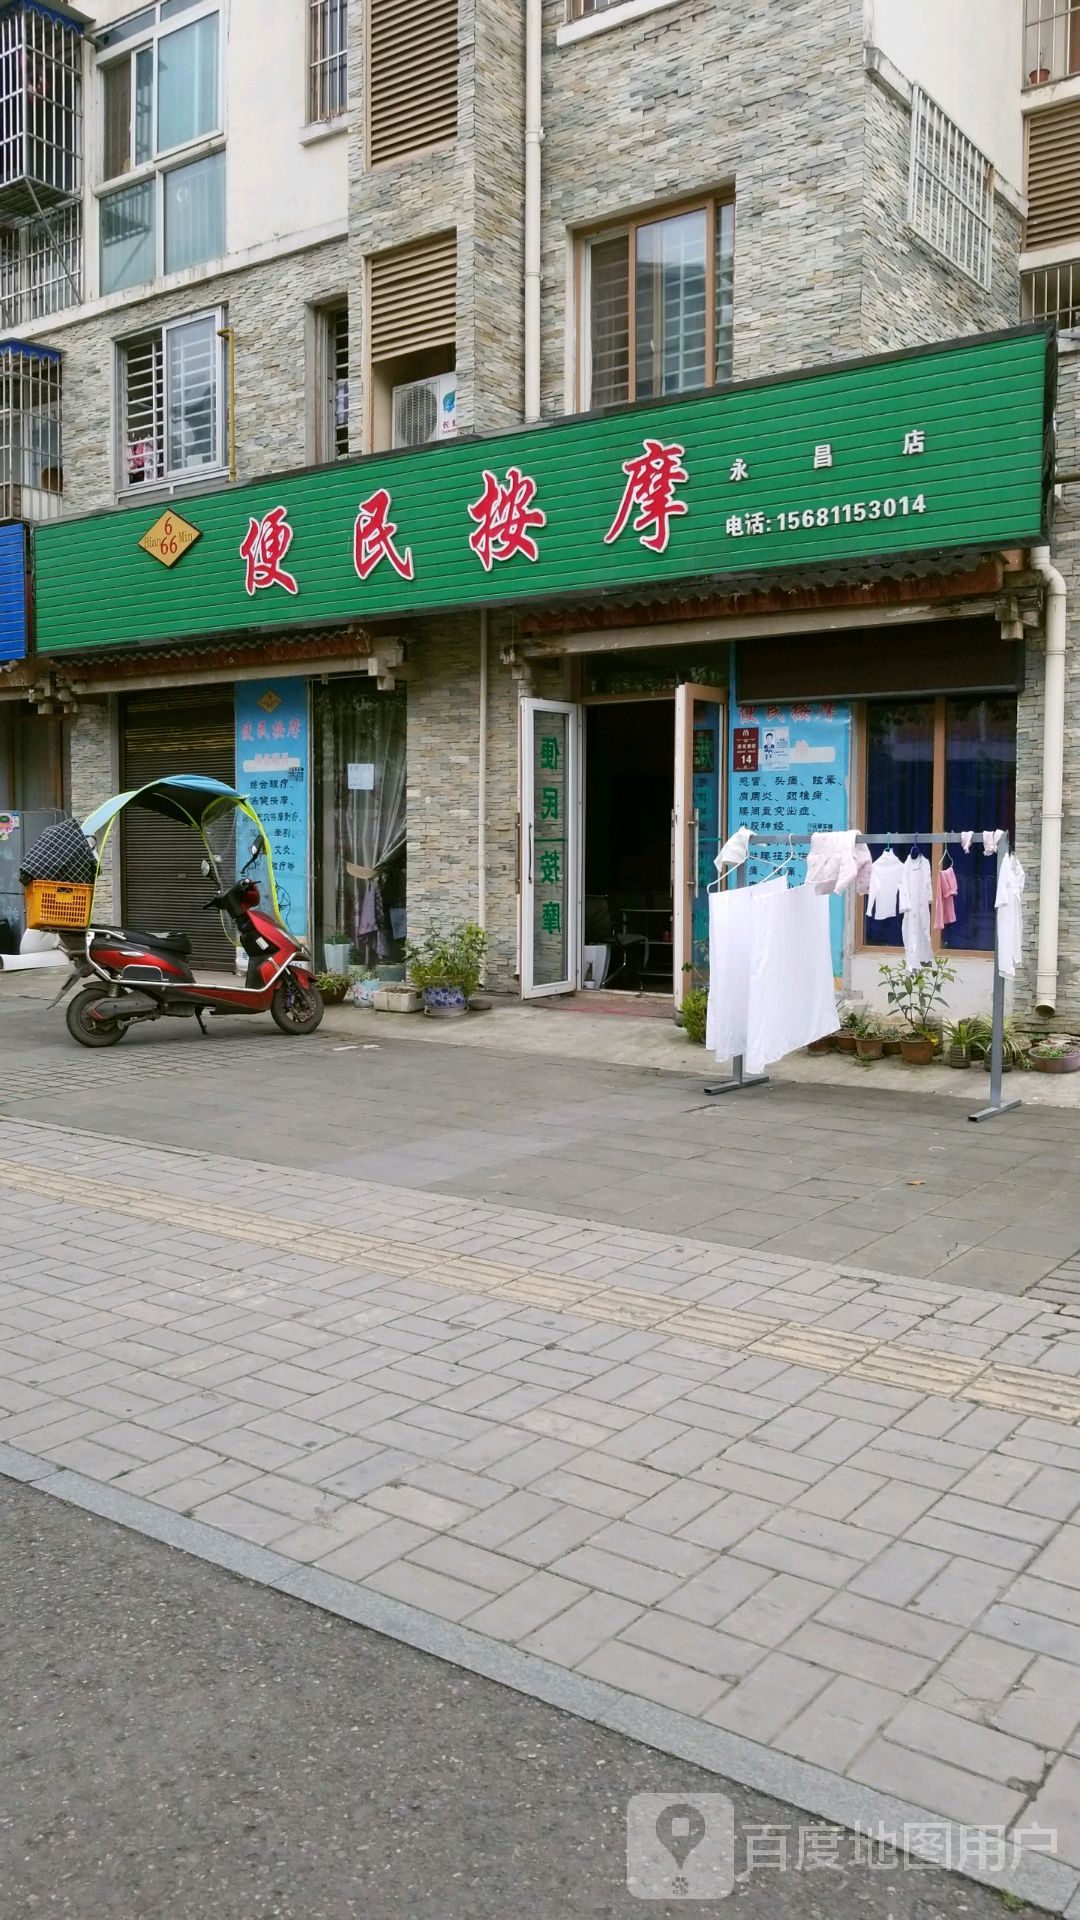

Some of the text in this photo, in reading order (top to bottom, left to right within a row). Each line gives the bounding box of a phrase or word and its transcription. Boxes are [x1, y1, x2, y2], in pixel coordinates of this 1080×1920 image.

[729, 430, 926, 482] 永昌店
[164, 516, 173, 536] 6
[240, 437, 690, 597] 便民按摩
[160, 535, 178, 555] 66
[178, 530, 193, 543] Min
[741, 754, 752, 764] 14
